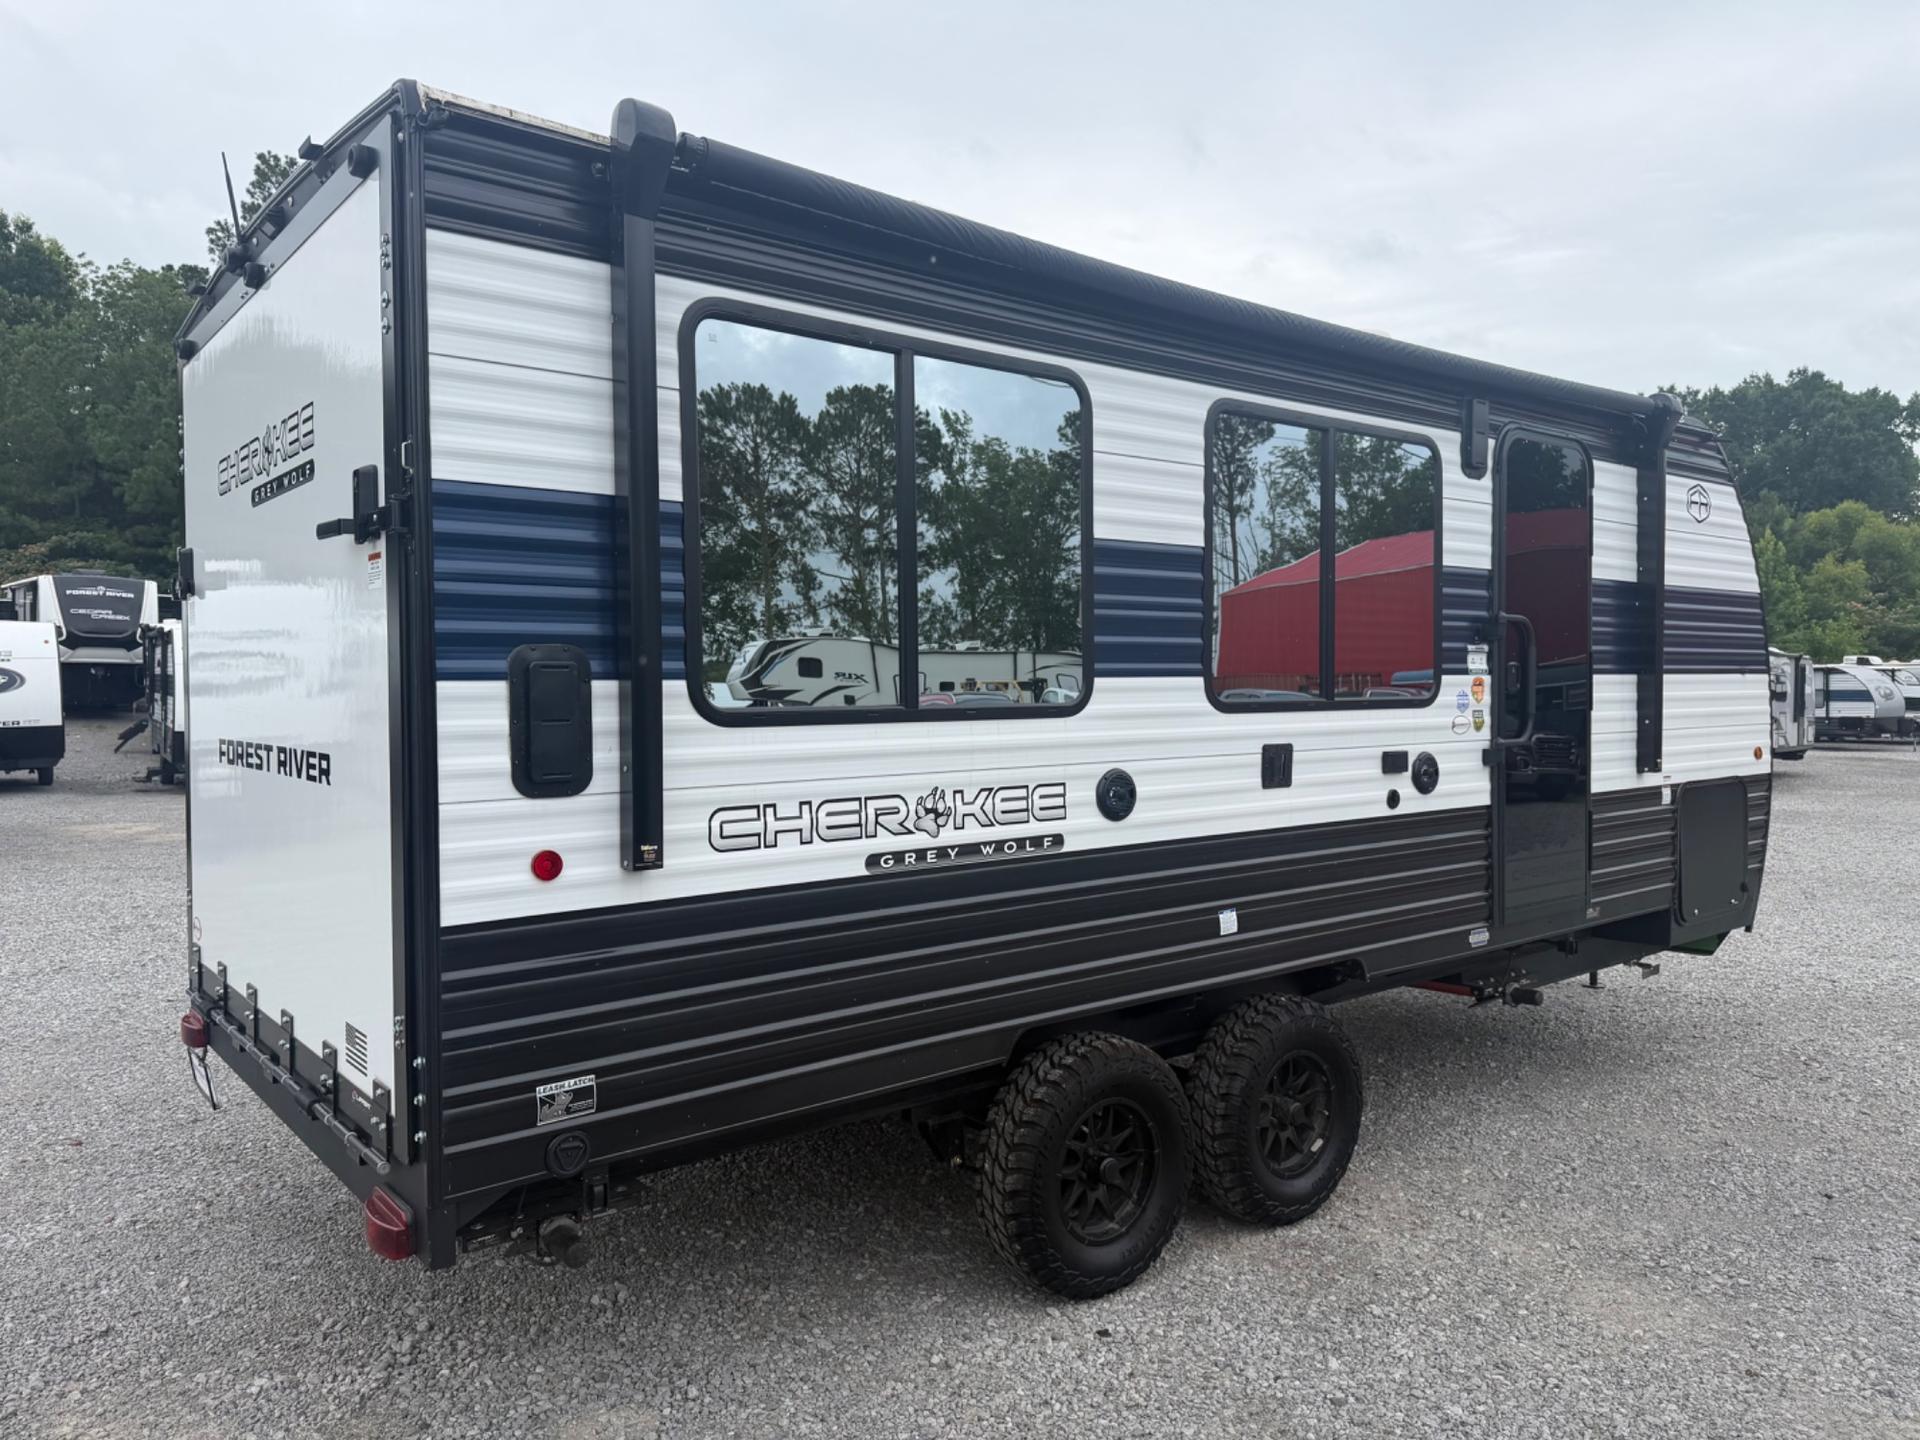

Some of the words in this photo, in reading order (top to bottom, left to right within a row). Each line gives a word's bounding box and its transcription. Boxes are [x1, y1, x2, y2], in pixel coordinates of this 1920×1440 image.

[254, 481, 279, 504] GREY
[283, 464, 312, 489] WOLF
[106, 591, 134, 599] RIVER
[218, 738, 274, 772] FOREST
[276, 746, 331, 786] RIVER
[879, 847, 959, 869] GREY
[980, 837, 1055, 857] WOLF
[537, 1084, 566, 1095] LEASH
[567, 1077, 594, 1088] LATCH
